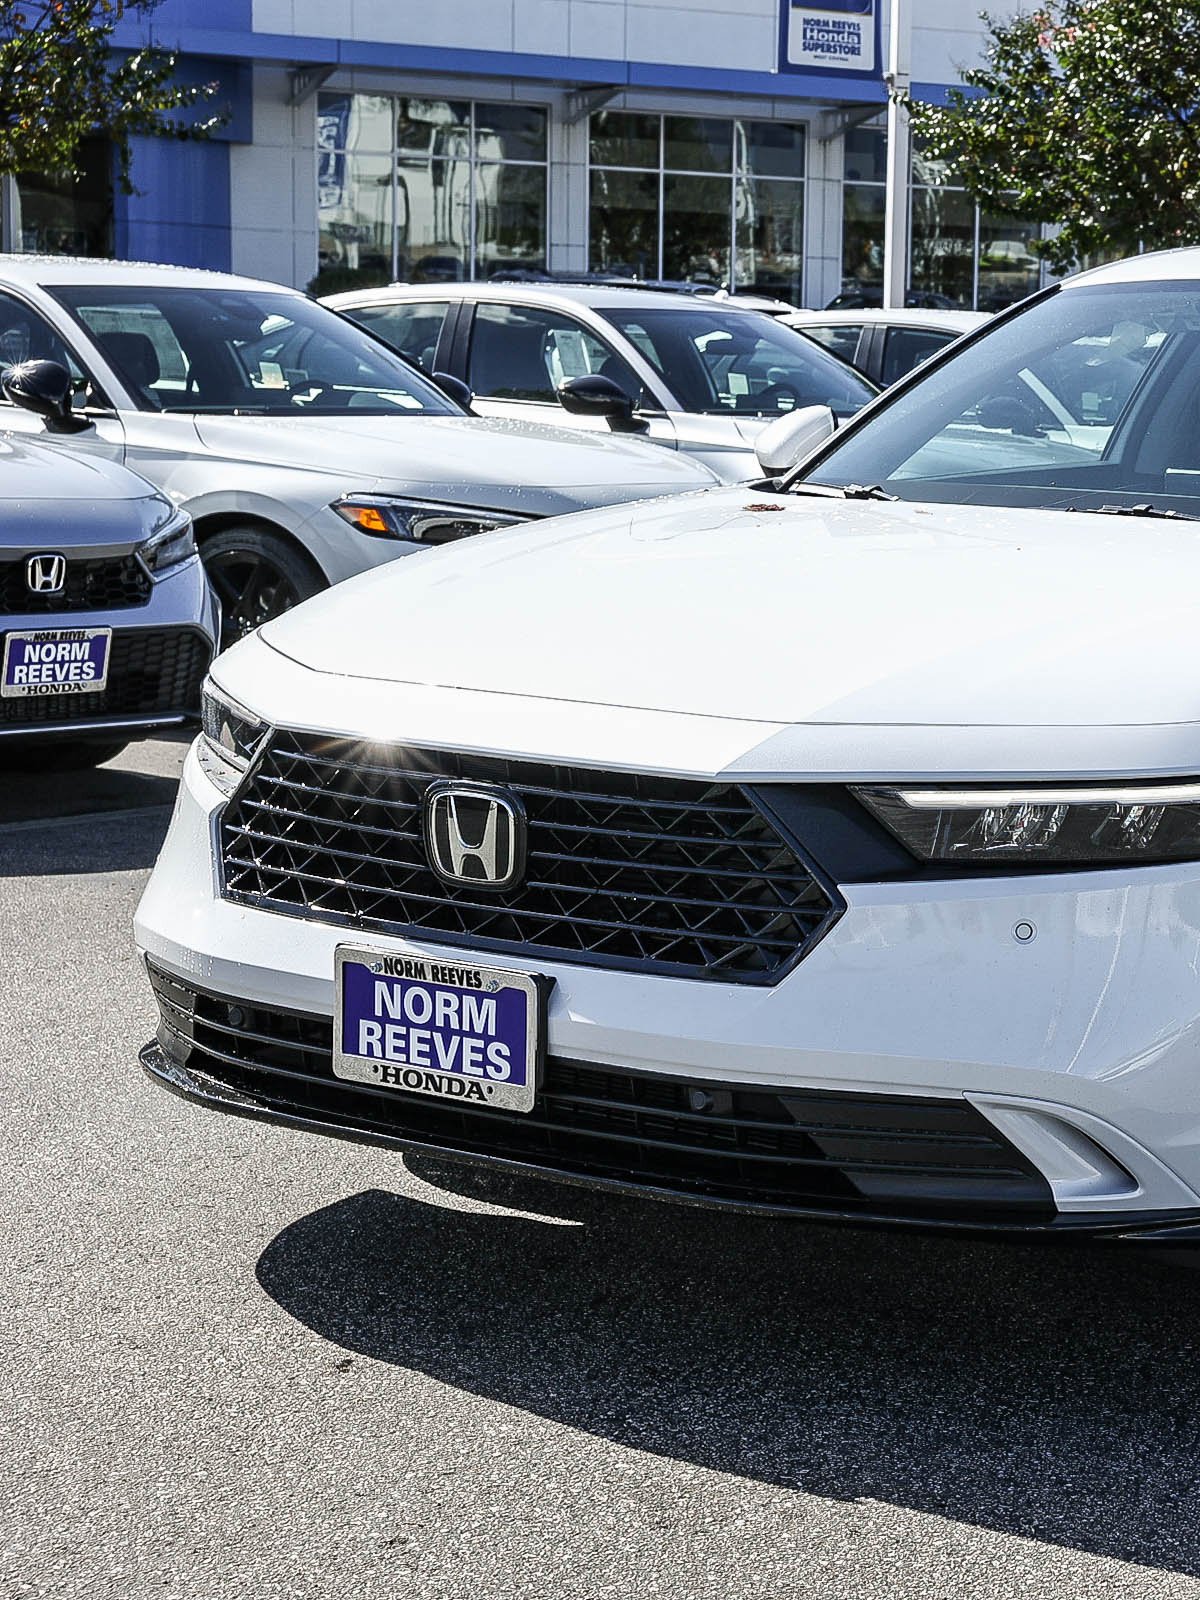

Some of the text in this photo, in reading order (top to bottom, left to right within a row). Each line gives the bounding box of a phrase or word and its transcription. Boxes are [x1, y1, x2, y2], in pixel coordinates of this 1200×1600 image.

[802, 18, 861, 31] NORM REEVES
[806, 28, 859, 43] Honda
[802, 41, 861, 56] SUPERSTORE
[33, 631, 86, 642] NORM REEVES
[24, 642, 90, 663] NORM
[14, 661, 96, 684] REEVES
[26, 683, 83, 695] HONDA
[383, 957, 482, 989] NORM REEVES
[374, 980, 496, 1036] NORM
[359, 1019, 511, 1081] REEVES
[380, 1065, 488, 1101] HONDA
